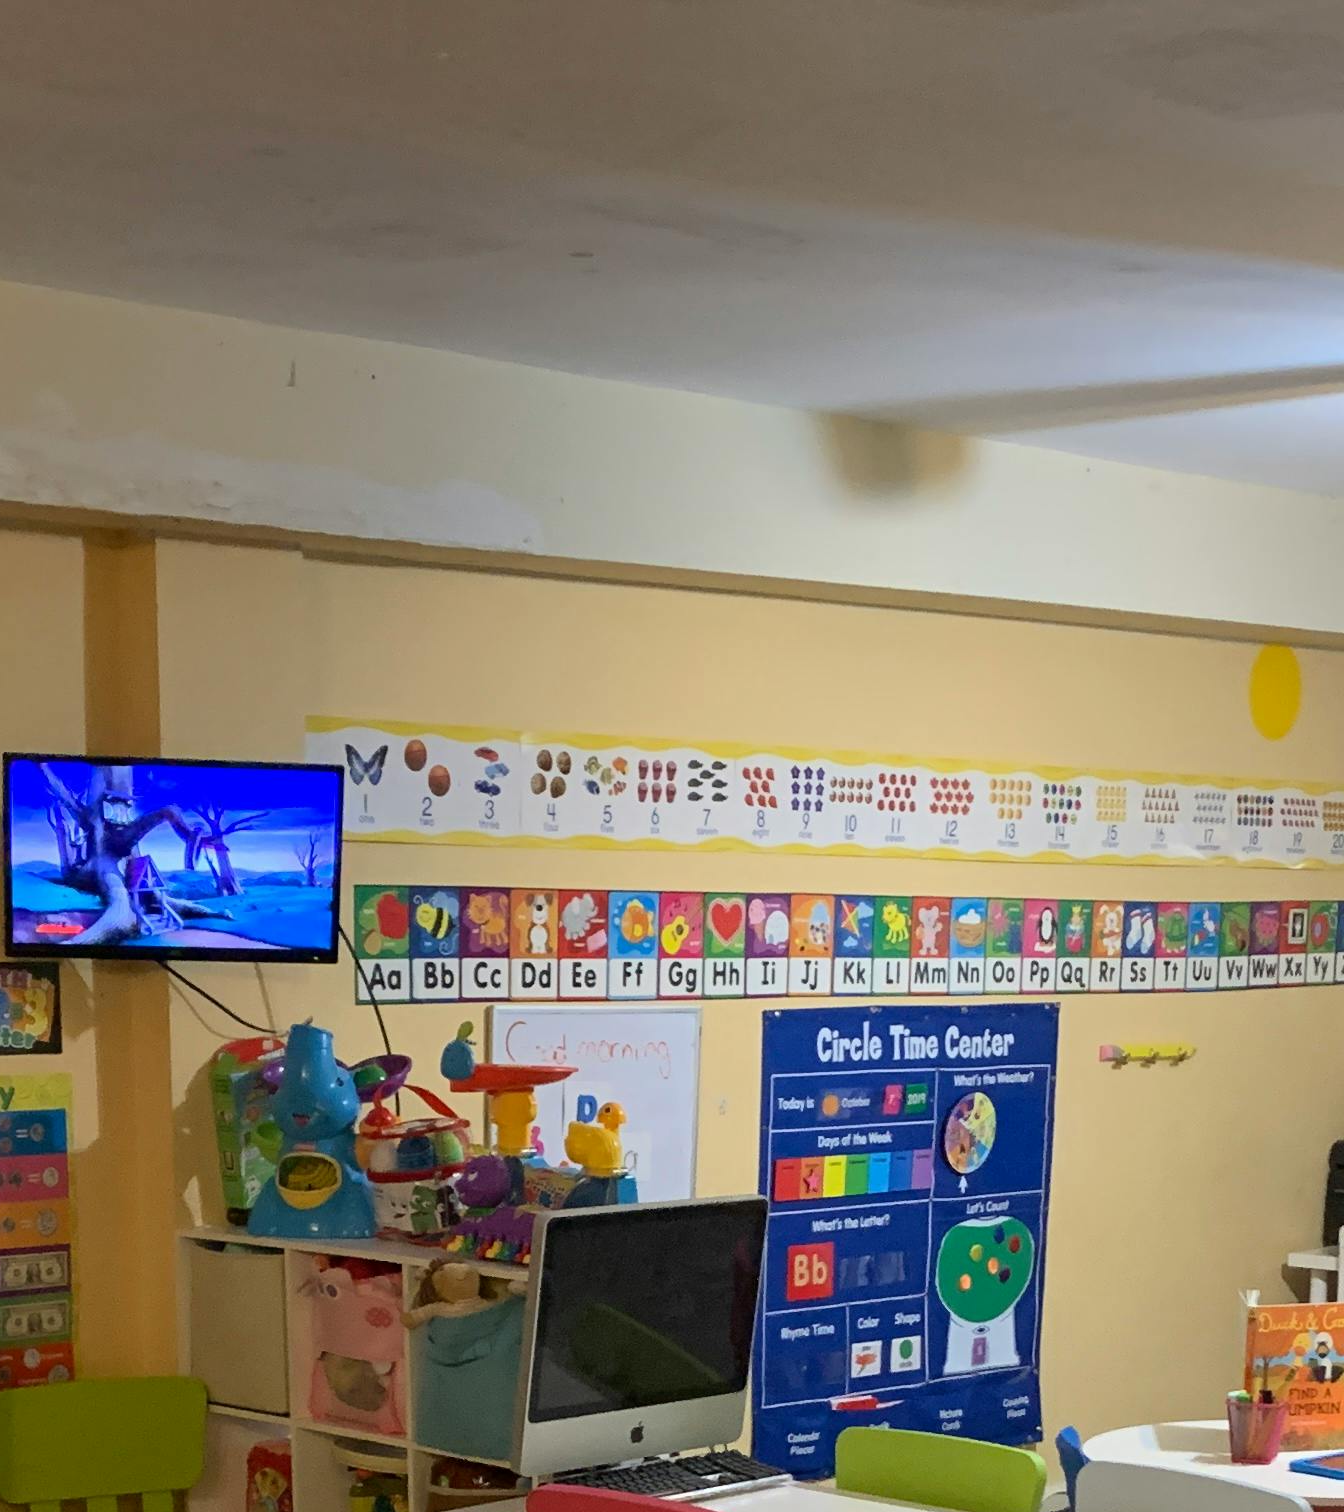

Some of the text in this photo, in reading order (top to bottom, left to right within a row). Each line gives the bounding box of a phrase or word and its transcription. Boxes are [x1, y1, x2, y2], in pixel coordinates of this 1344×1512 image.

[422, 797, 433, 817] 2
[484, 800, 495, 819] 3
[546, 803, 556, 822] 4
[602, 805, 613, 823] 5
[651, 806, 660, 825] 6
[702, 809, 711, 826] 7
[756, 810, 765, 828] 8
[802, 813, 810, 829] 9
[845, 814, 857, 832] 10
[945, 820, 958, 837] 12
[1006, 823, 1016, 840] 13
[1106, 825, 1118, 840] 15
[1203, 828, 1214, 843] 17
[1248, 829, 1259, 845] 18
[1332, 833, 1344, 849] 20
[369, 963, 402, 990] Aa
[424, 961, 454, 989] Bb
[474, 961, 501, 989] Cc
[521, 962, 551, 988] Dd
[571, 961, 597, 988] Ee
[622, 961, 643, 987] Ff
[669, 961, 697, 992] Gg
[713, 961, 739, 986] Hh
[761, 961, 776, 985] Ii
[801, 960, 819, 990] Jj
[843, 961, 866, 984] Kk
[886, 961, 900, 984] Ll
[914, 961, 946, 984] Mm
[957, 961, 980, 984] Nn
[992, 961, 1015, 983] Oo
[1030, 960, 1049, 988] Pp
[1061, 960, 1086, 988] Qq
[1098, 960, 1115, 982] Rr
[1129, 961, 1147, 982] Ss
[1163, 960, 1178, 982] Tt
[1192, 959, 1212, 981] Uu
[1226, 958, 1243, 978] Vv
[1252, 957, 1276, 979] Ww
[1284, 956, 1303, 977] Xx
[1312, 955, 1329, 980] Yy
[816, 1021, 1015, 1062] Circle Time Center
[983, 1073, 996, 1085] the
[577, 1094, 598, 1123] D
[778, 1097, 804, 1112] Today
[806, 1097, 814, 1108] is
[818, 1131, 892, 1149] Days of the Week
[812, 1214, 890, 1232] What's the Letter?
[793, 1254, 828, 1287] Bb
[858, 1313, 921, 1329] Color Shape
[1258, 1312, 1303, 1332] Duck
[781, 1324, 835, 1341] Rhyme Time
[1289, 1387, 1332, 1401] FIND A
[1287, 1400, 1341, 1416] UMPKIN
